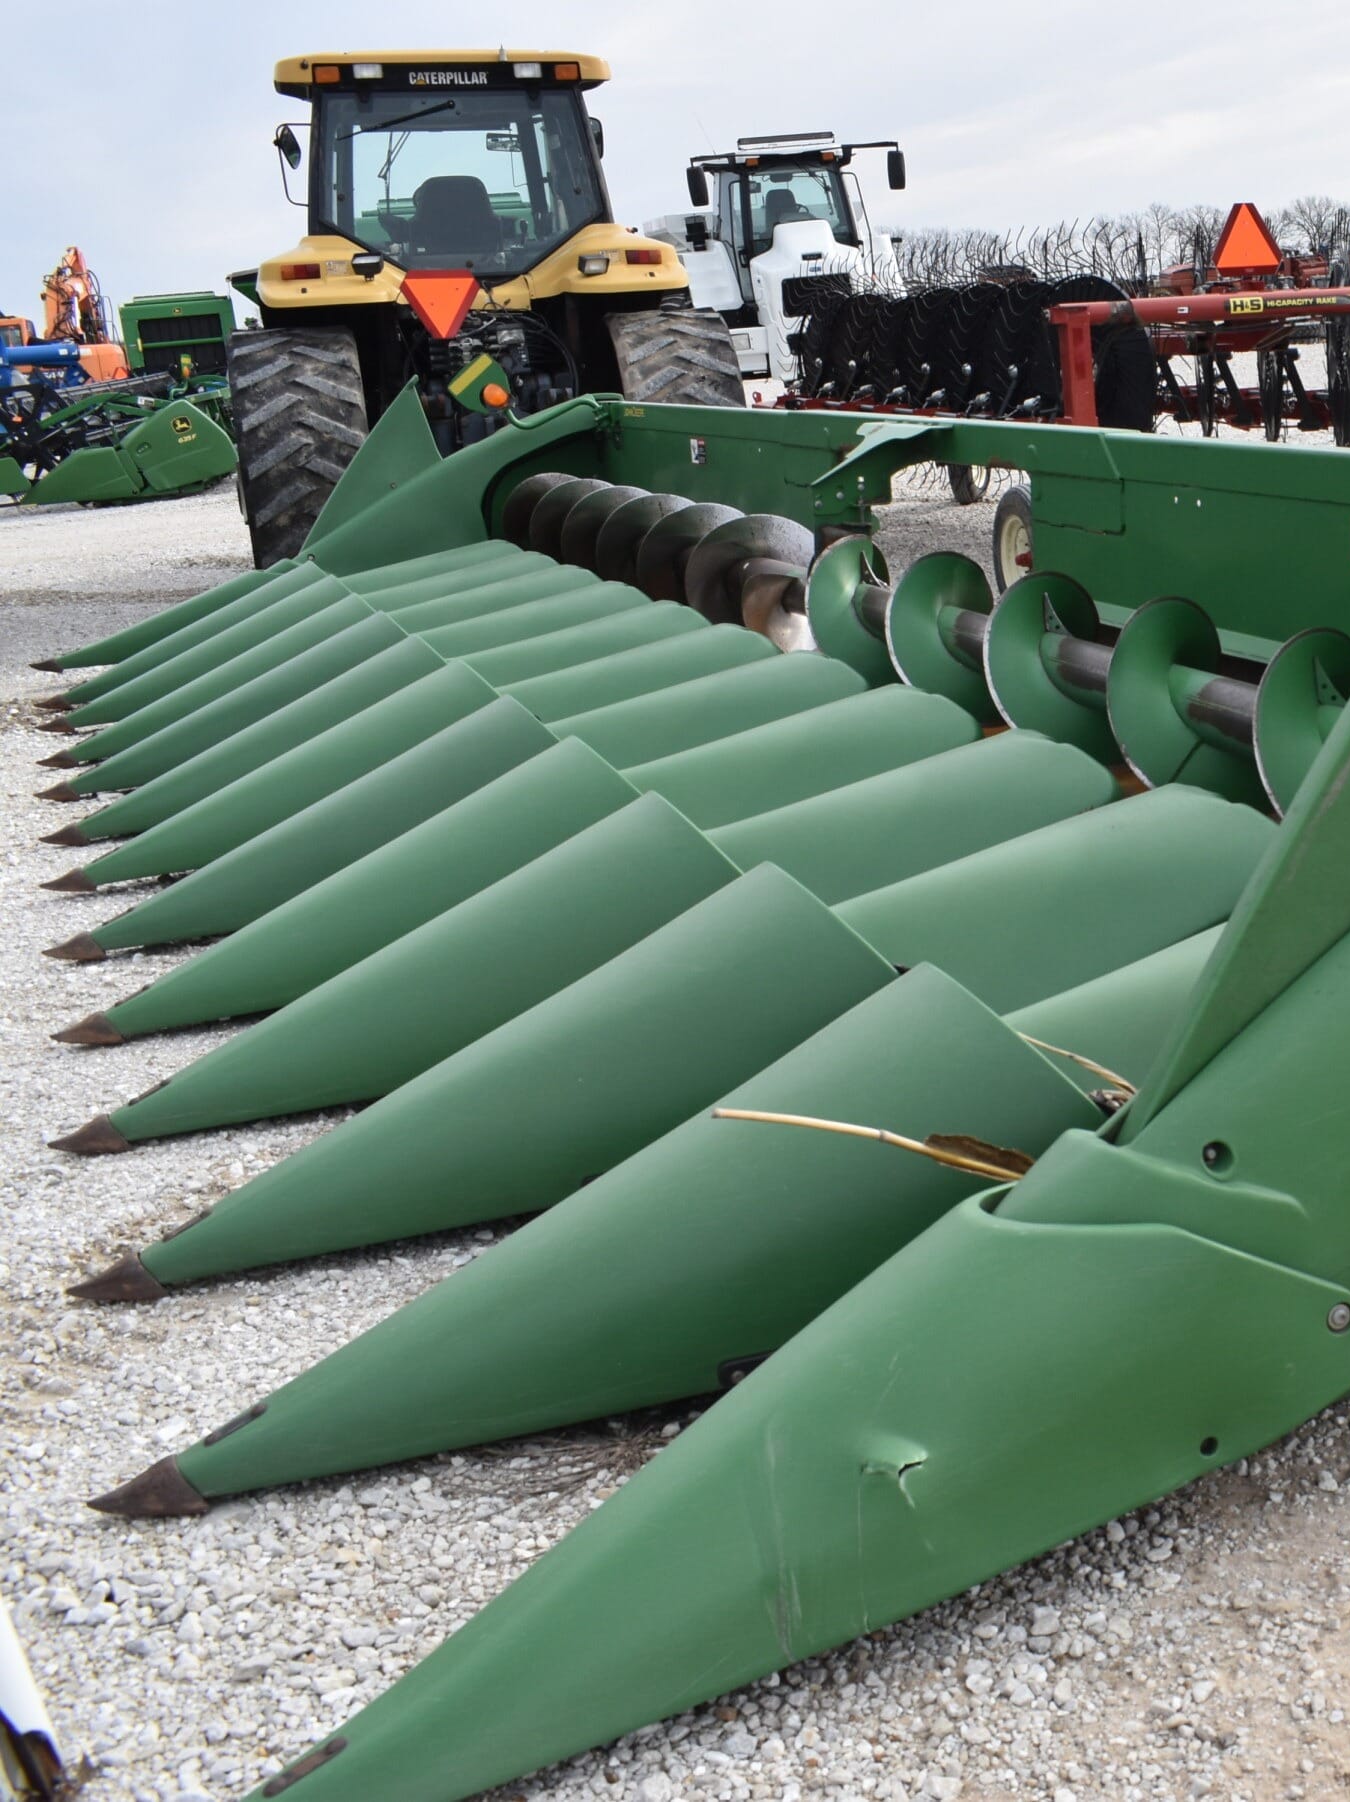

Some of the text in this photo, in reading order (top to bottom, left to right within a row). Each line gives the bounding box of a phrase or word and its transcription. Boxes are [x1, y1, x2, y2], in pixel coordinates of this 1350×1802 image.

[408, 71, 488, 85] CATERPILLAR
[1233, 299, 1261, 311] H&S
[1267, 298, 1313, 307] HI-CAPACITY
